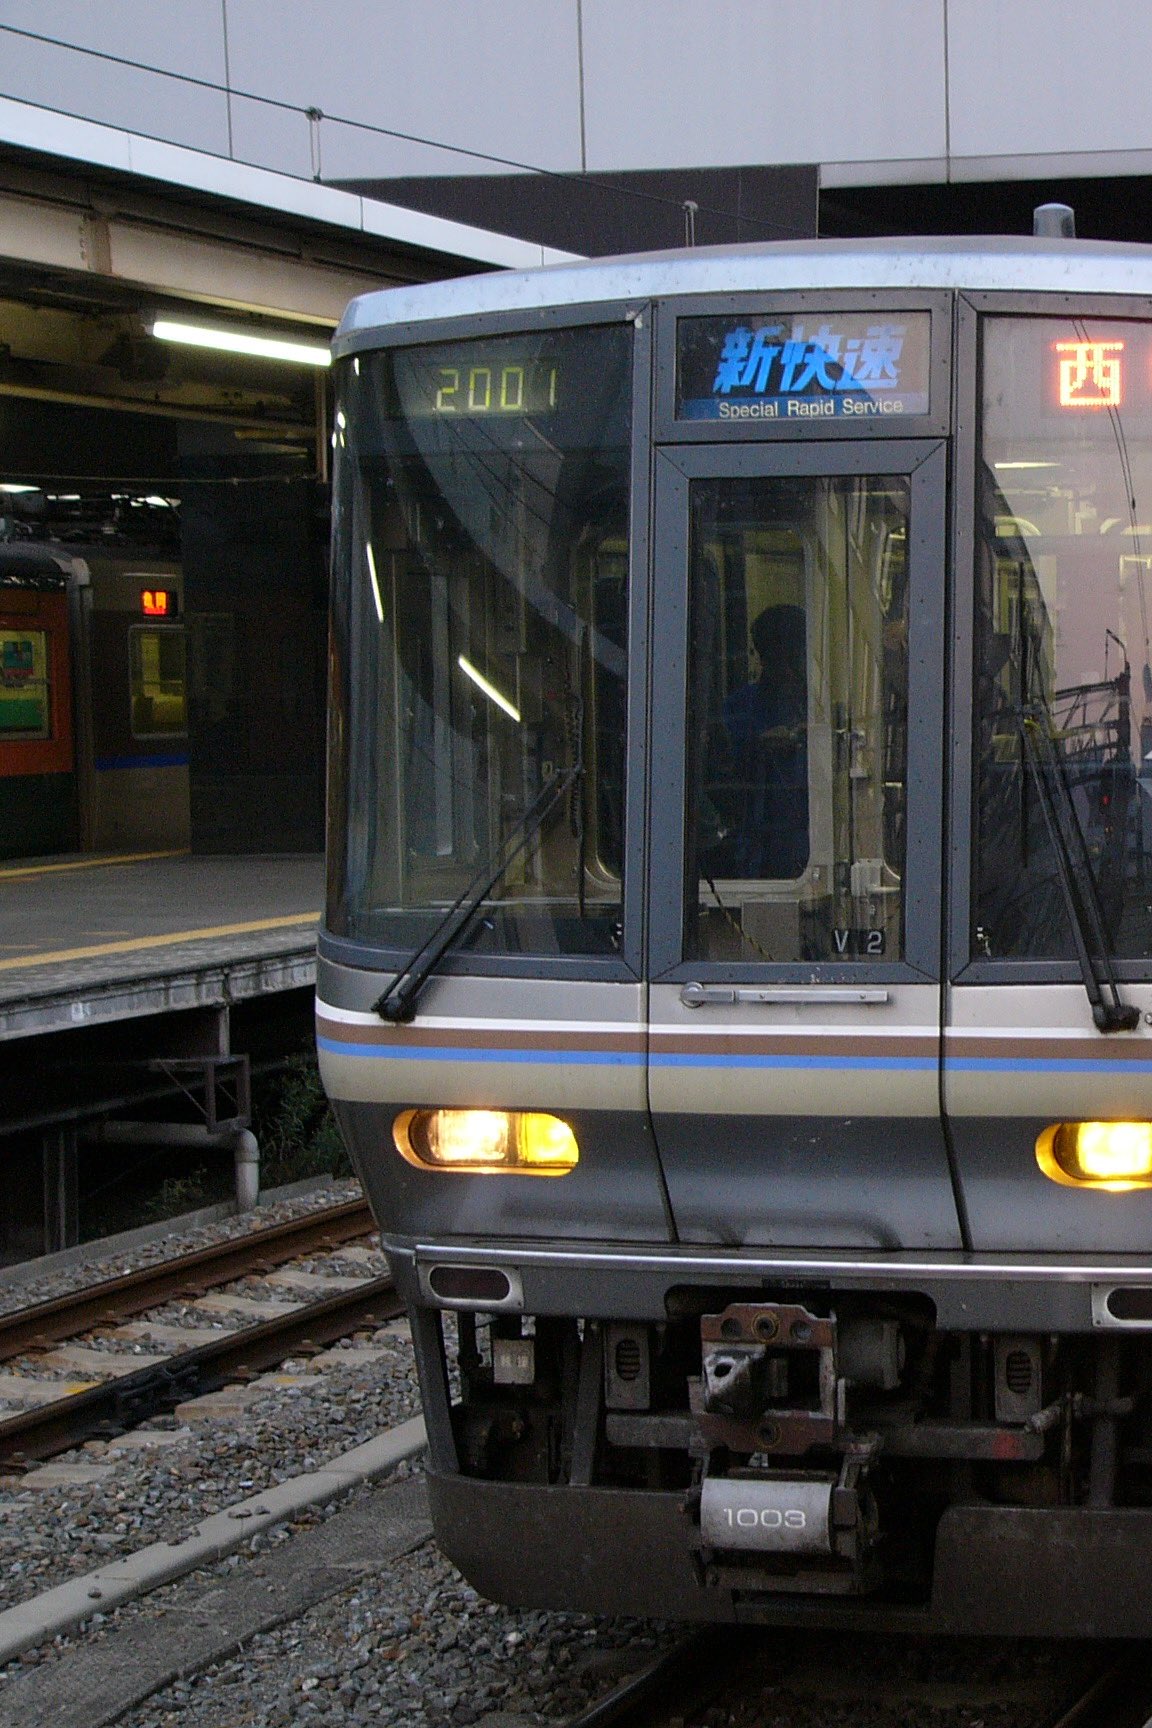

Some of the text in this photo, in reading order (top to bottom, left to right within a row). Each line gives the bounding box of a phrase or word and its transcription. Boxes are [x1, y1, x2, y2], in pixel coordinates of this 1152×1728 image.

[714, 326, 904, 394] 新快速
[434, 367, 557, 411] 2001
[718, 399, 904, 419] Special Rapid Service
[723, 1508, 806, 1528] 1003
